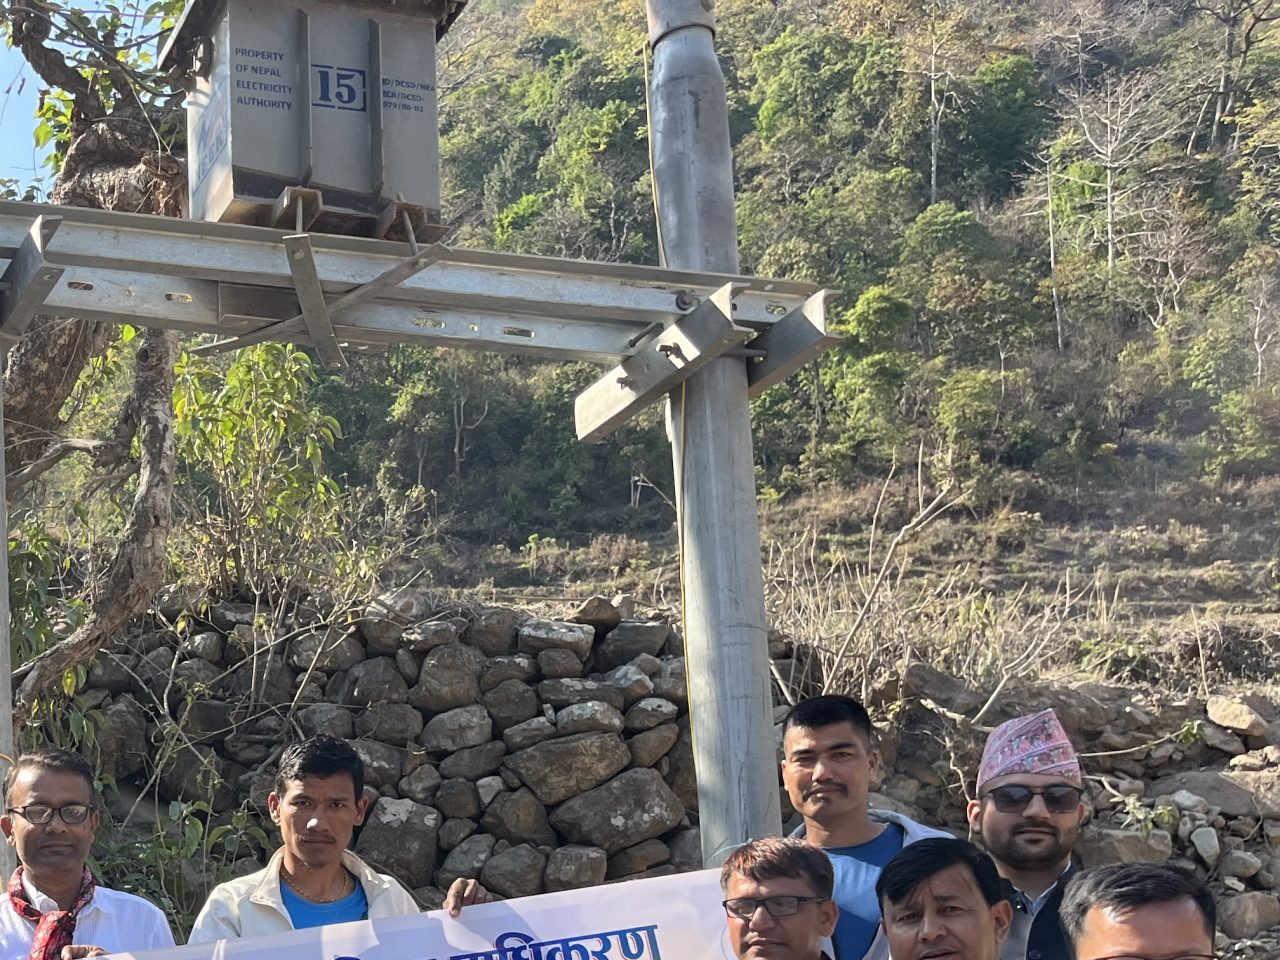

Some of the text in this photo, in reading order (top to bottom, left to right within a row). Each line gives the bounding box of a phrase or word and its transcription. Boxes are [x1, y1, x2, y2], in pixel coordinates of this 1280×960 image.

[235, 48, 284, 62] PROPERTY
[235, 64, 281, 78] OF NEPAL
[236, 80, 293, 95] ELECTRICITY
[318, 70, 357, 104] 15
[237, 96, 292, 111] AUTHORITY
